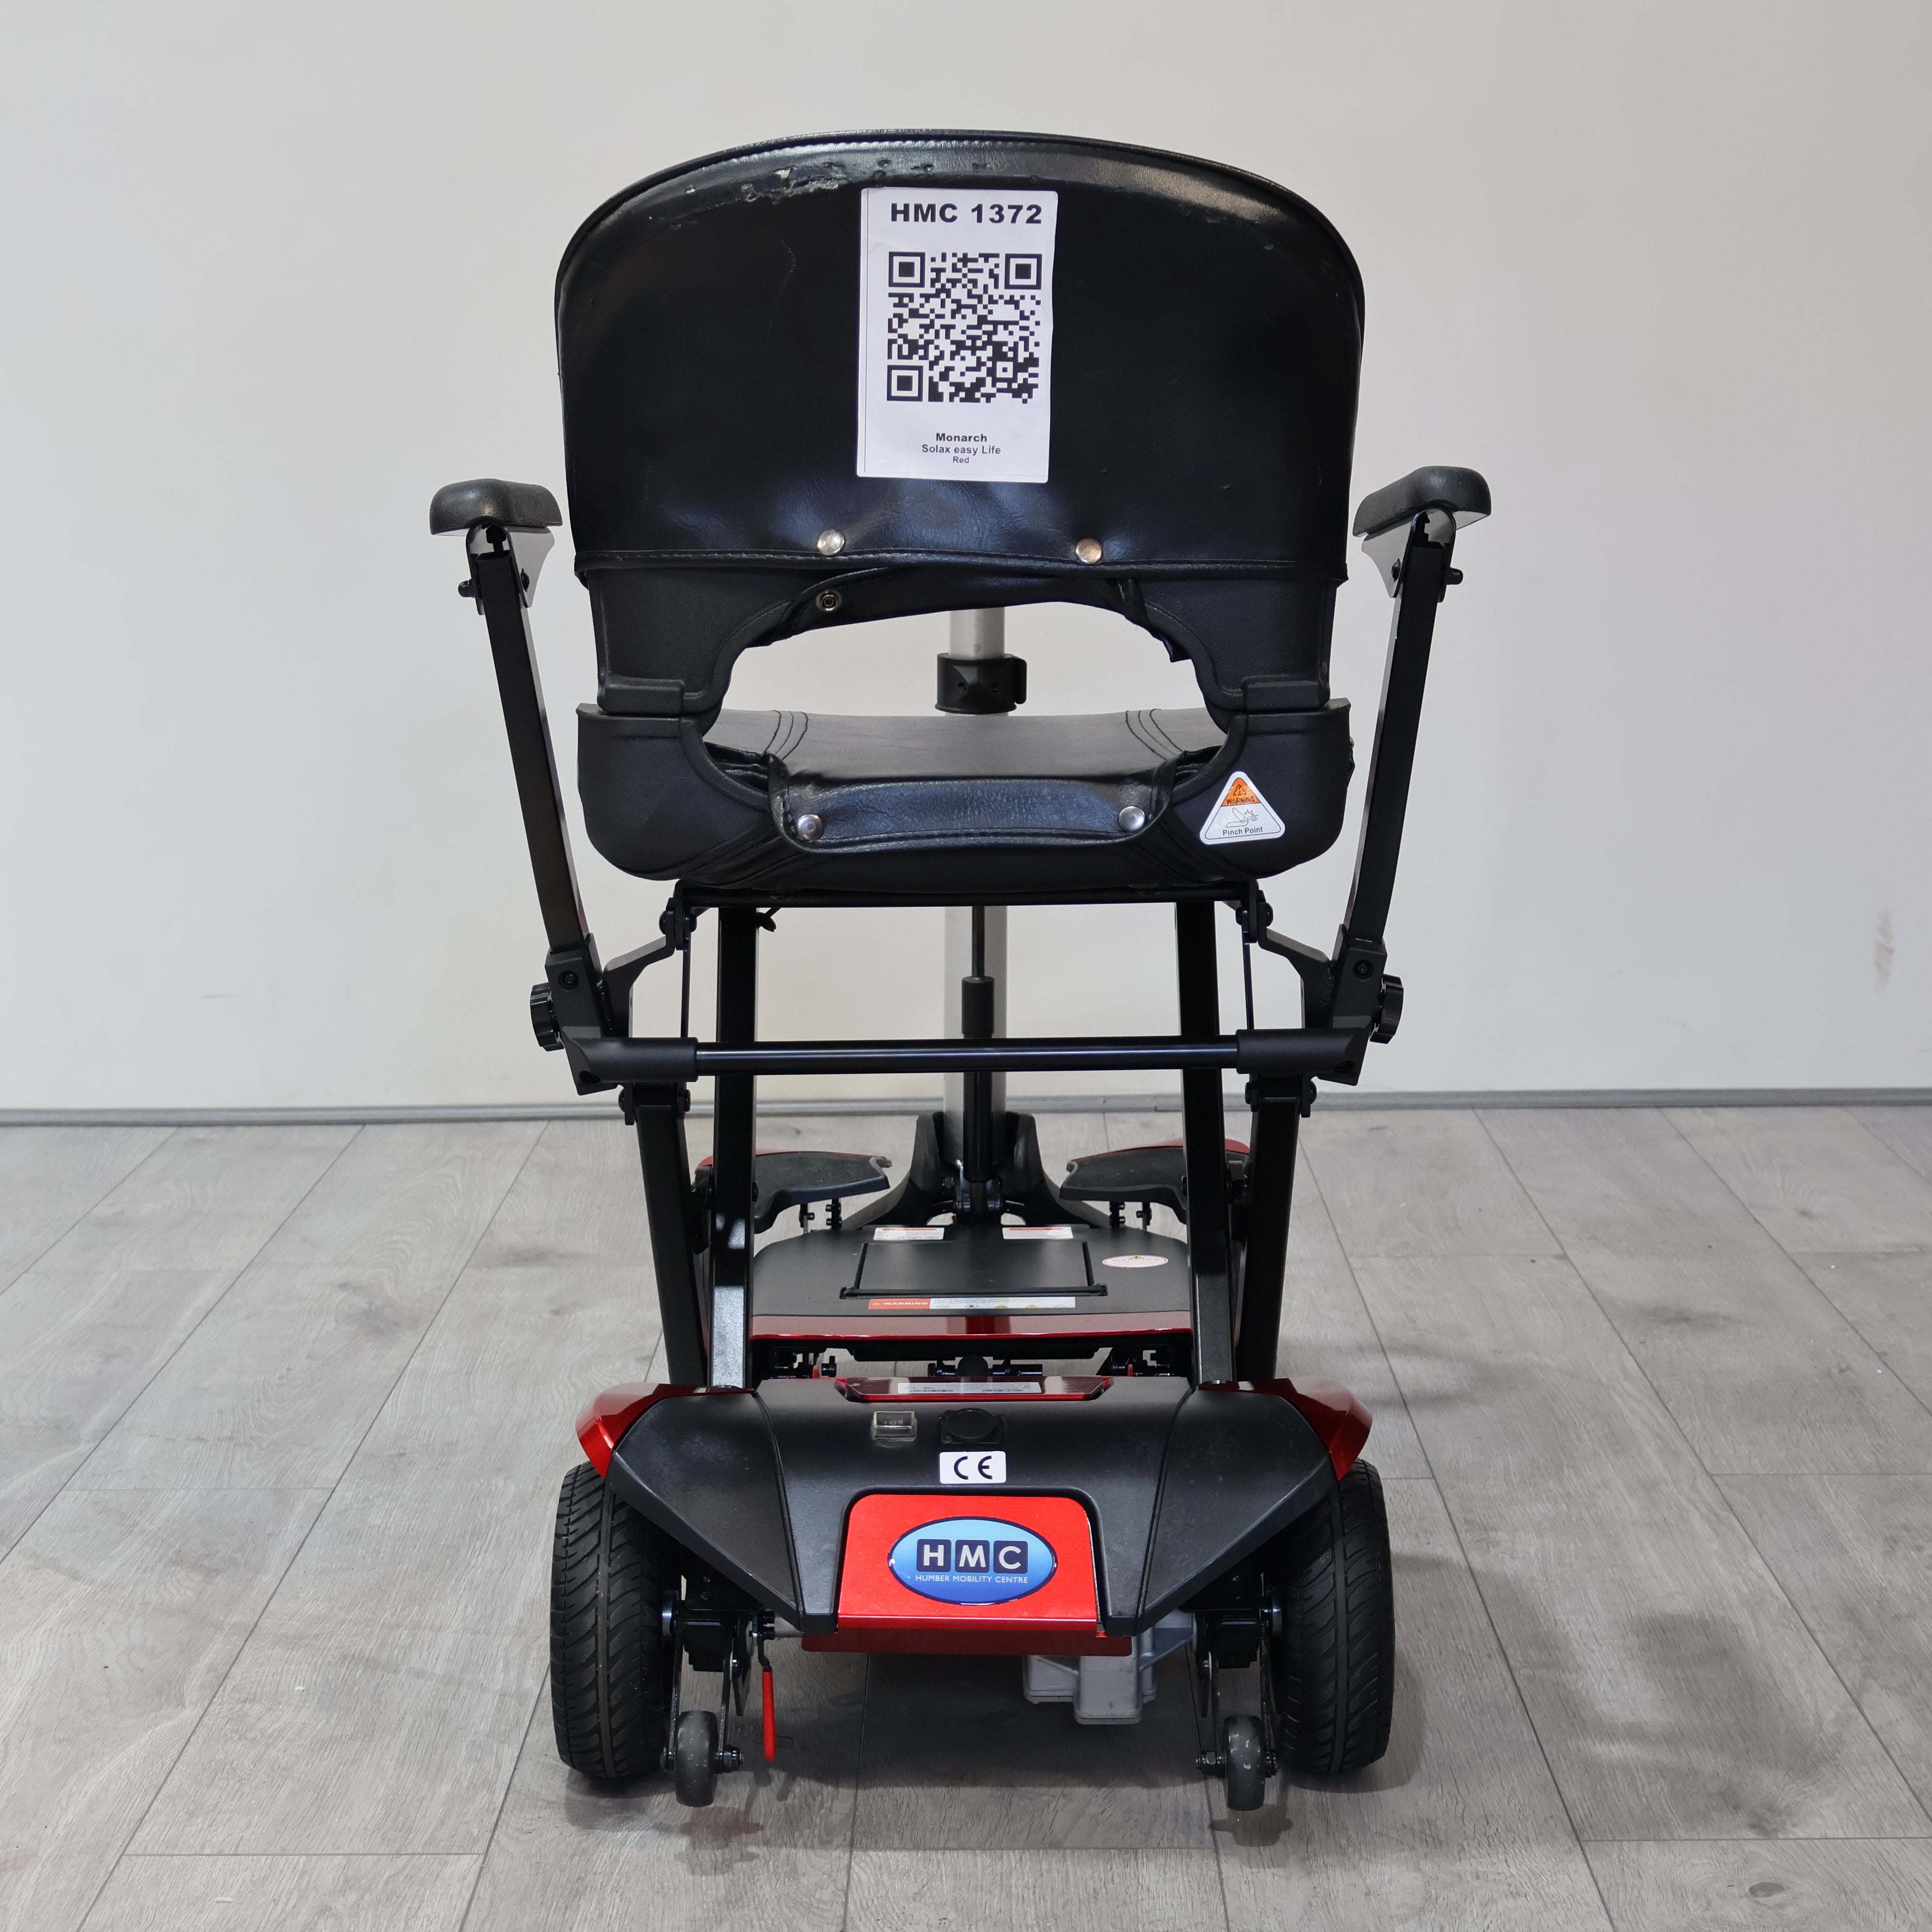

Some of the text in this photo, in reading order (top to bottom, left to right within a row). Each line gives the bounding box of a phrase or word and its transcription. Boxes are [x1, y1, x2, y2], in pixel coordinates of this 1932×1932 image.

[891, 203, 1042, 224] HMC 1372
[936, 432, 987, 442] Monarch
[922, 444, 1001, 456] Solax easy Life
[1226, 796, 1255, 805] WARNING
[1222, 826, 1263, 836] Pinch Point
[923, 1544, 1022, 1570] HMC
